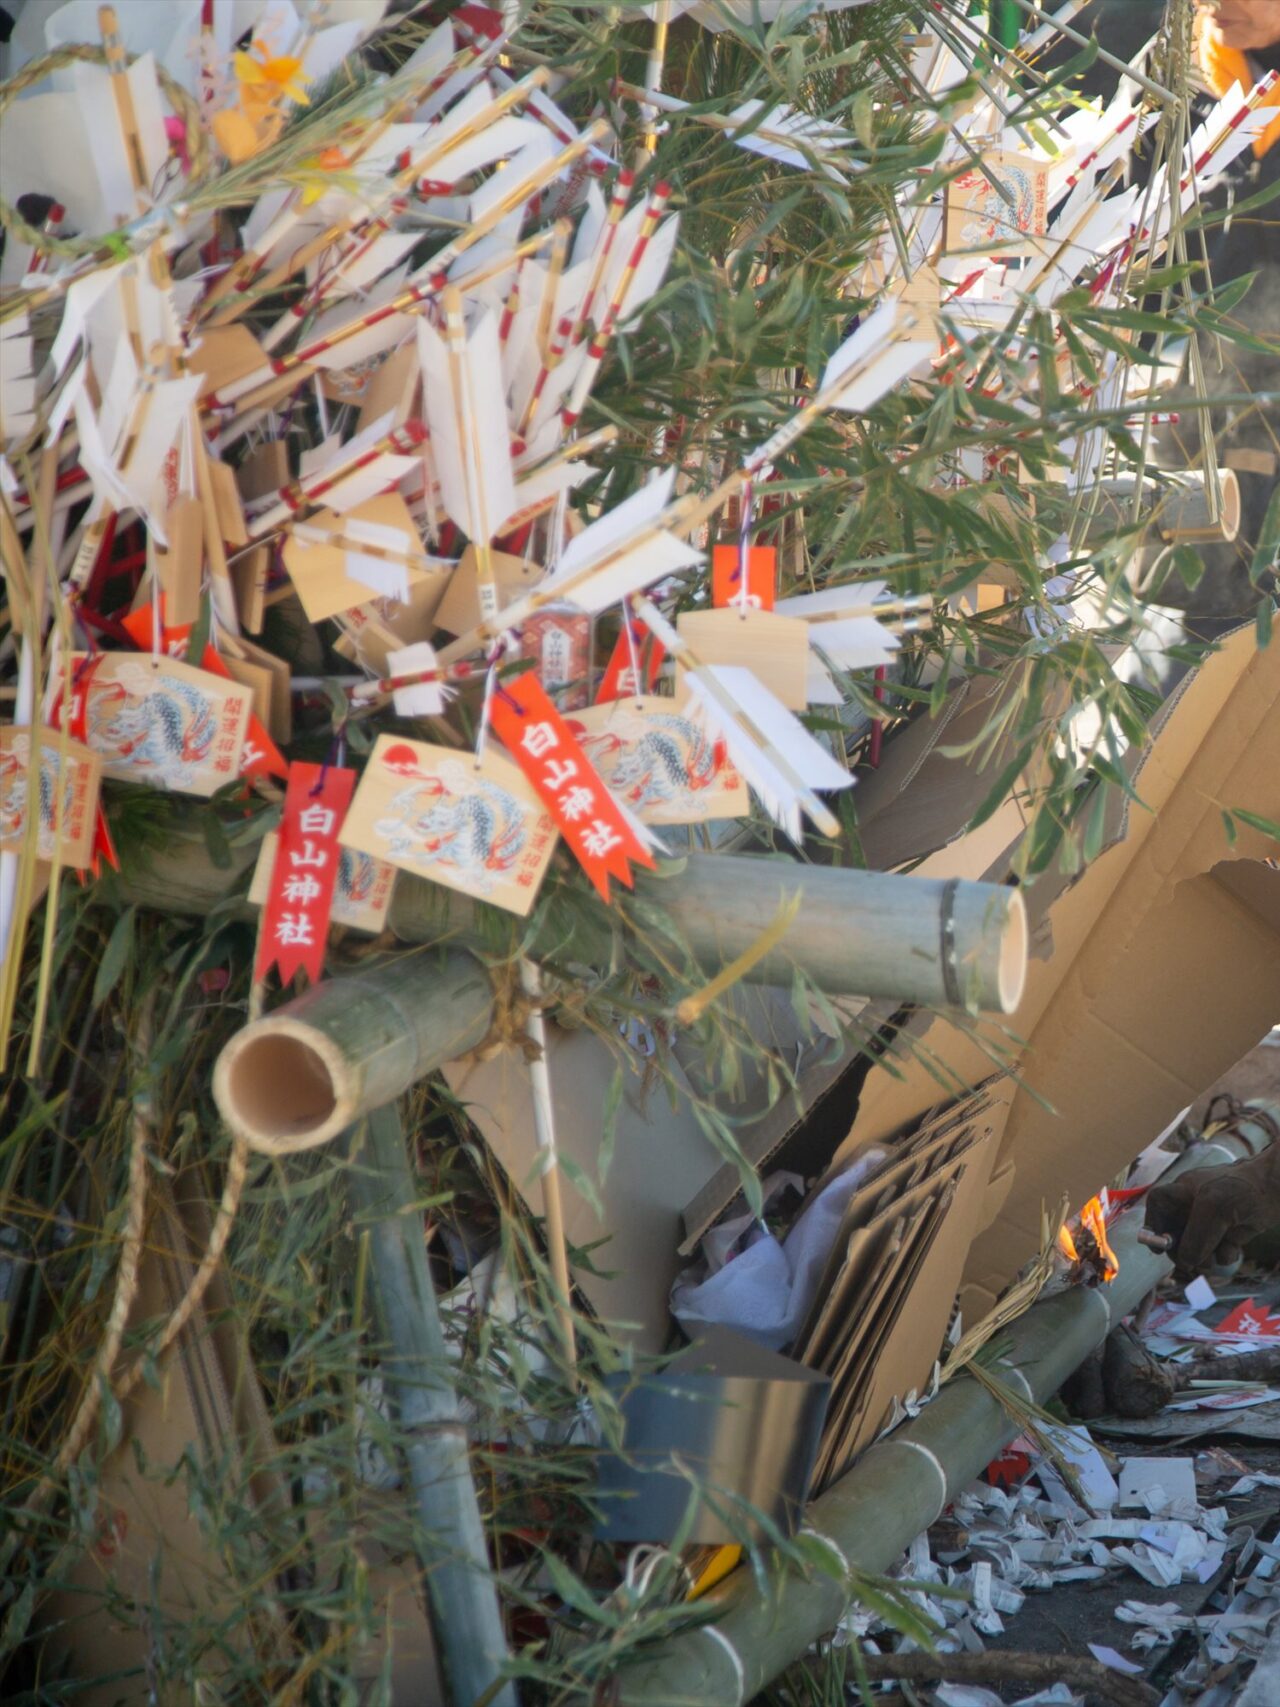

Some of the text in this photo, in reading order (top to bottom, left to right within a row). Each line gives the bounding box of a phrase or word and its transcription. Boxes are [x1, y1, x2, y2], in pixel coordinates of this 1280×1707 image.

[520, 721, 624, 858] 白山神社
[274, 803, 335, 945] 白山神社
